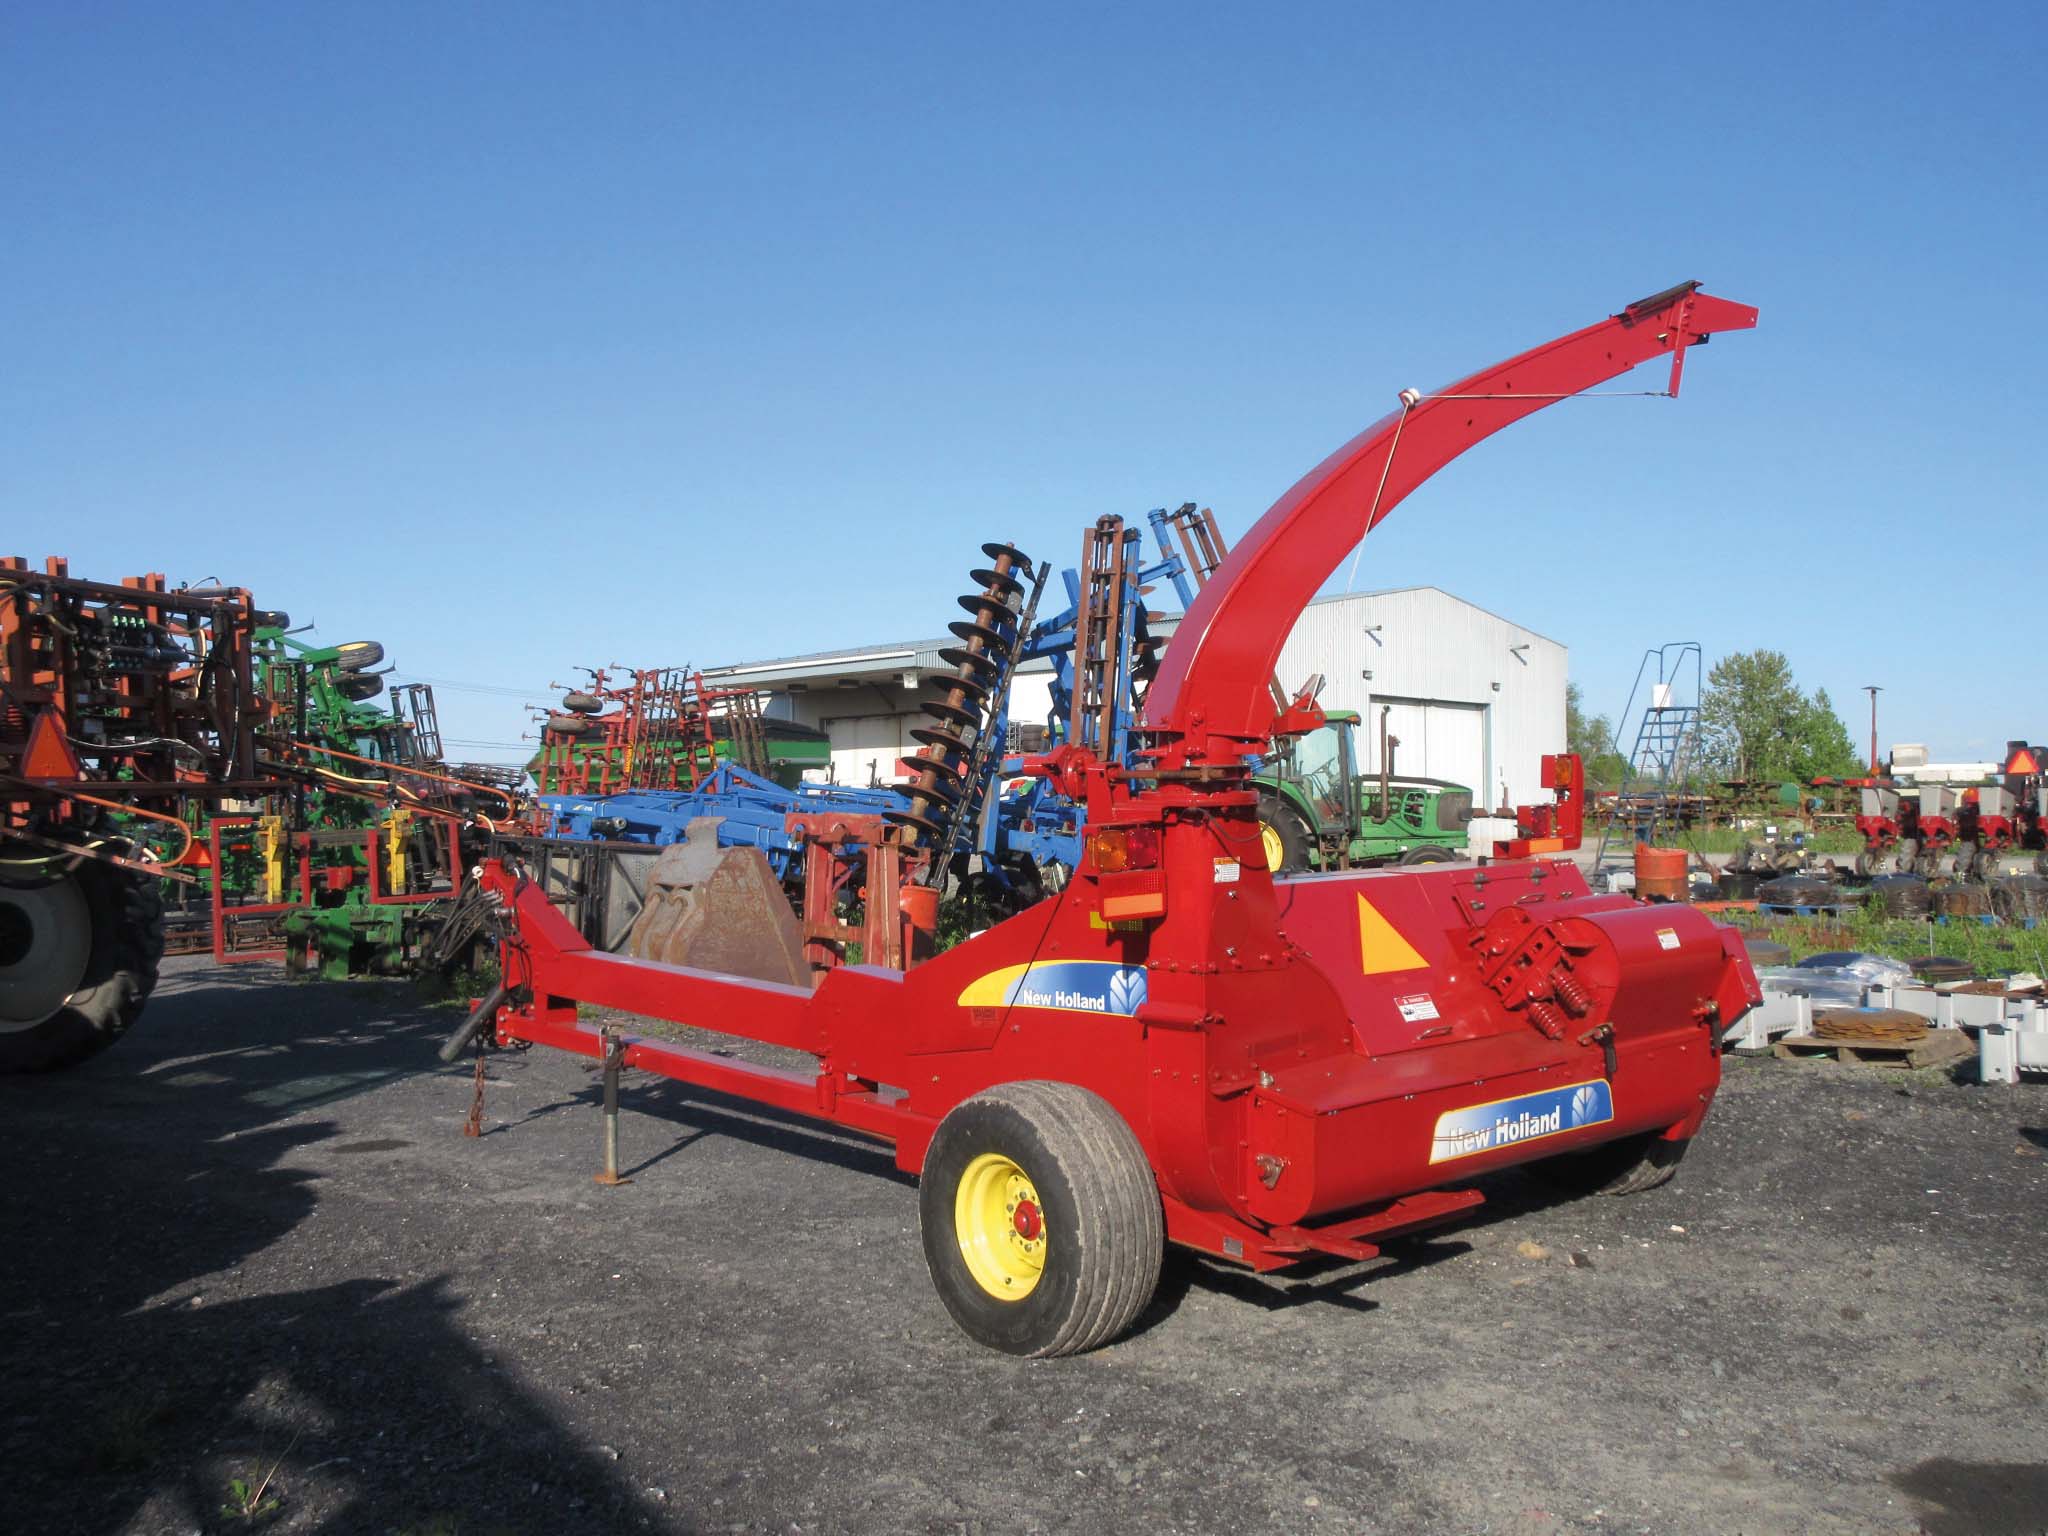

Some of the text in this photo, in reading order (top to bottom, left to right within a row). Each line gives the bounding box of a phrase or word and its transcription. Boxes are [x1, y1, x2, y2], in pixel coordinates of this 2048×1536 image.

[1023, 989, 1105, 1011] New Holland
[1449, 1105, 1560, 1157] New Holland
